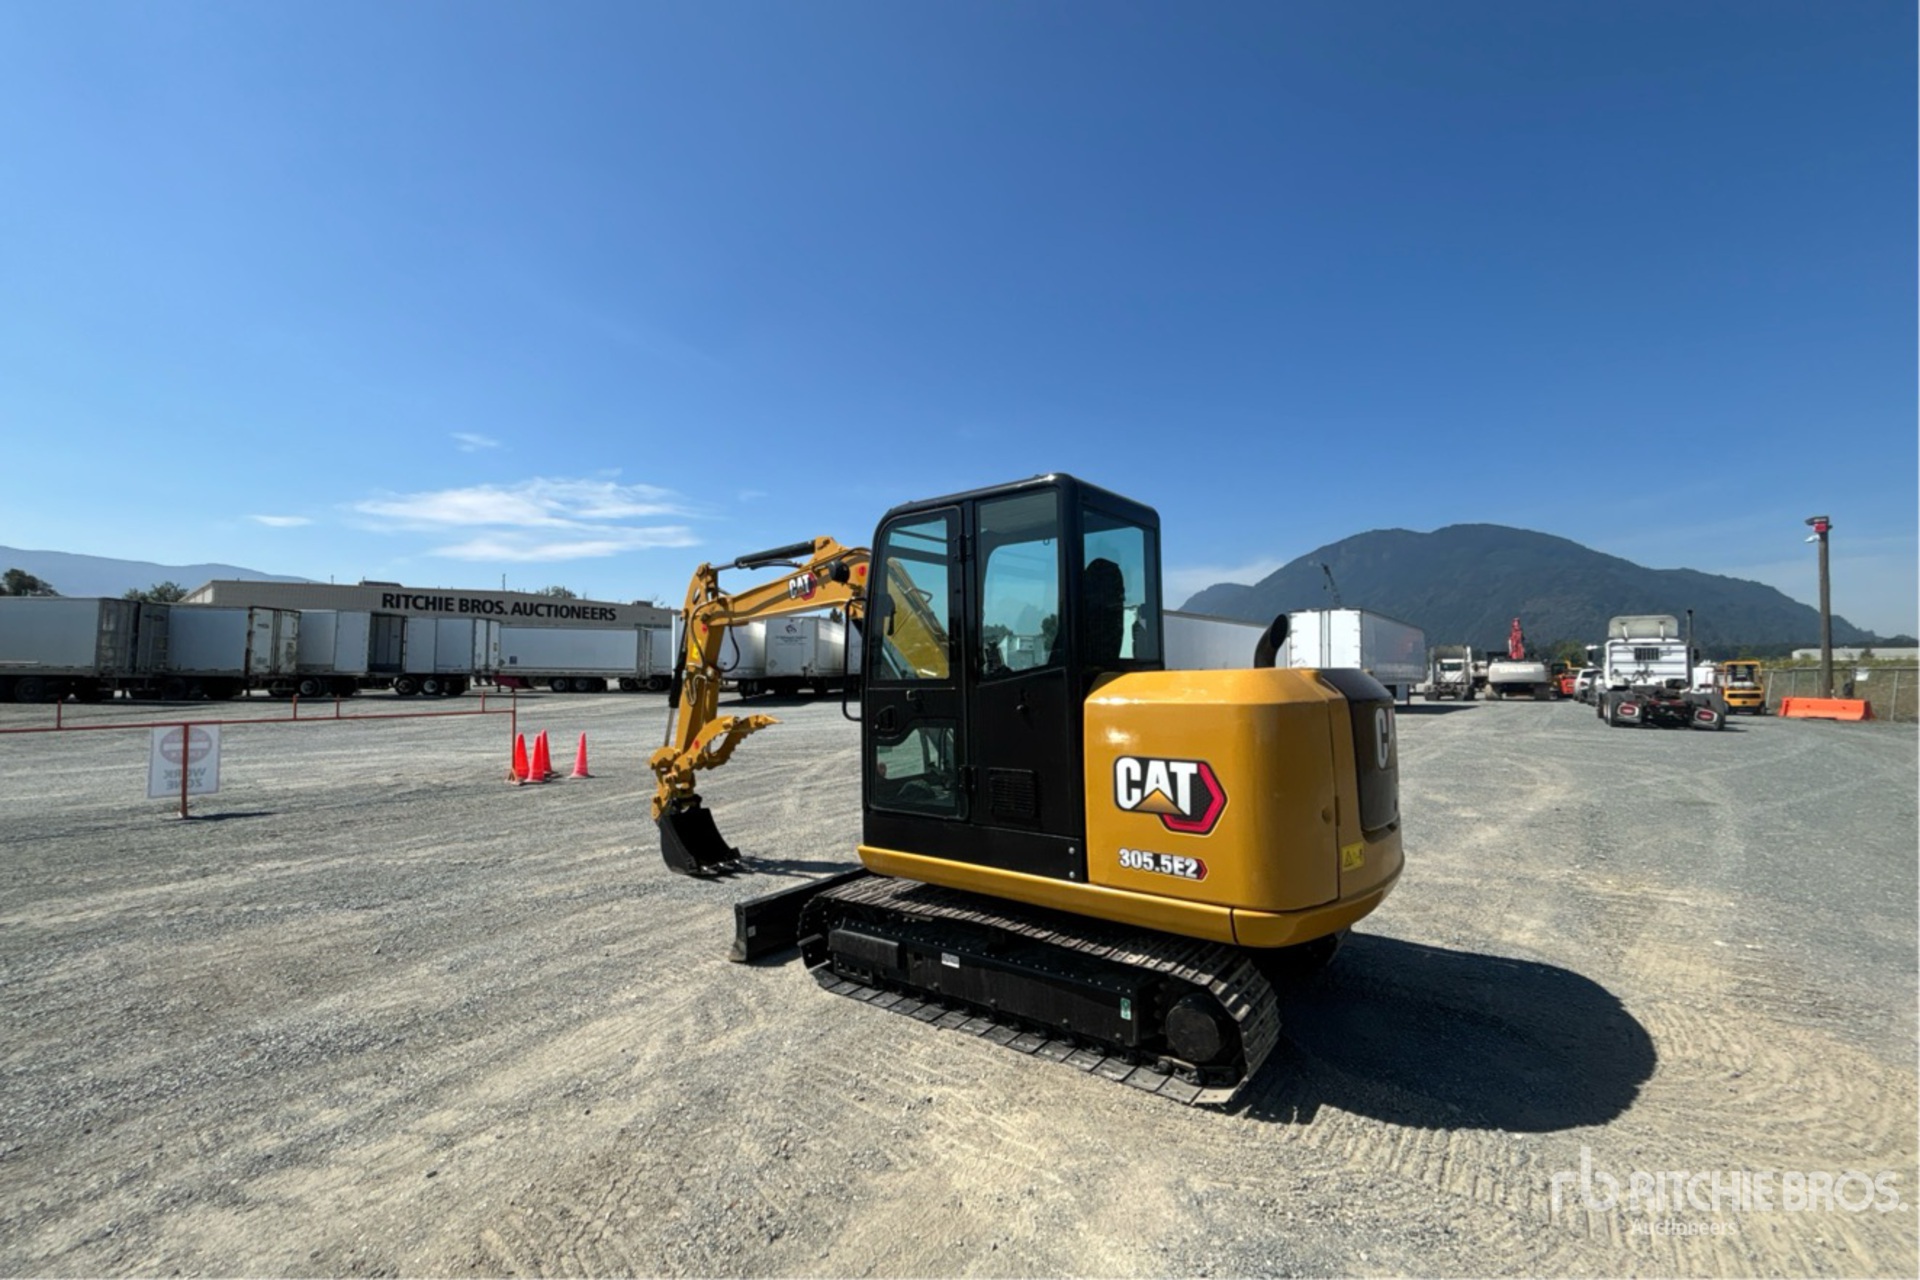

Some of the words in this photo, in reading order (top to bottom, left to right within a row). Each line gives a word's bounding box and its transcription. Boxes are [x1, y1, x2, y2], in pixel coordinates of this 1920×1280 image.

[788, 573, 810, 599] CAT
[381, 592, 455, 612] RITCHIE
[458, 597, 509, 616] BROS.
[510, 601, 617, 621] AUCTIONEERS
[1115, 756, 1198, 816] CAT
[1118, 848, 1199, 879] 305.5E2
